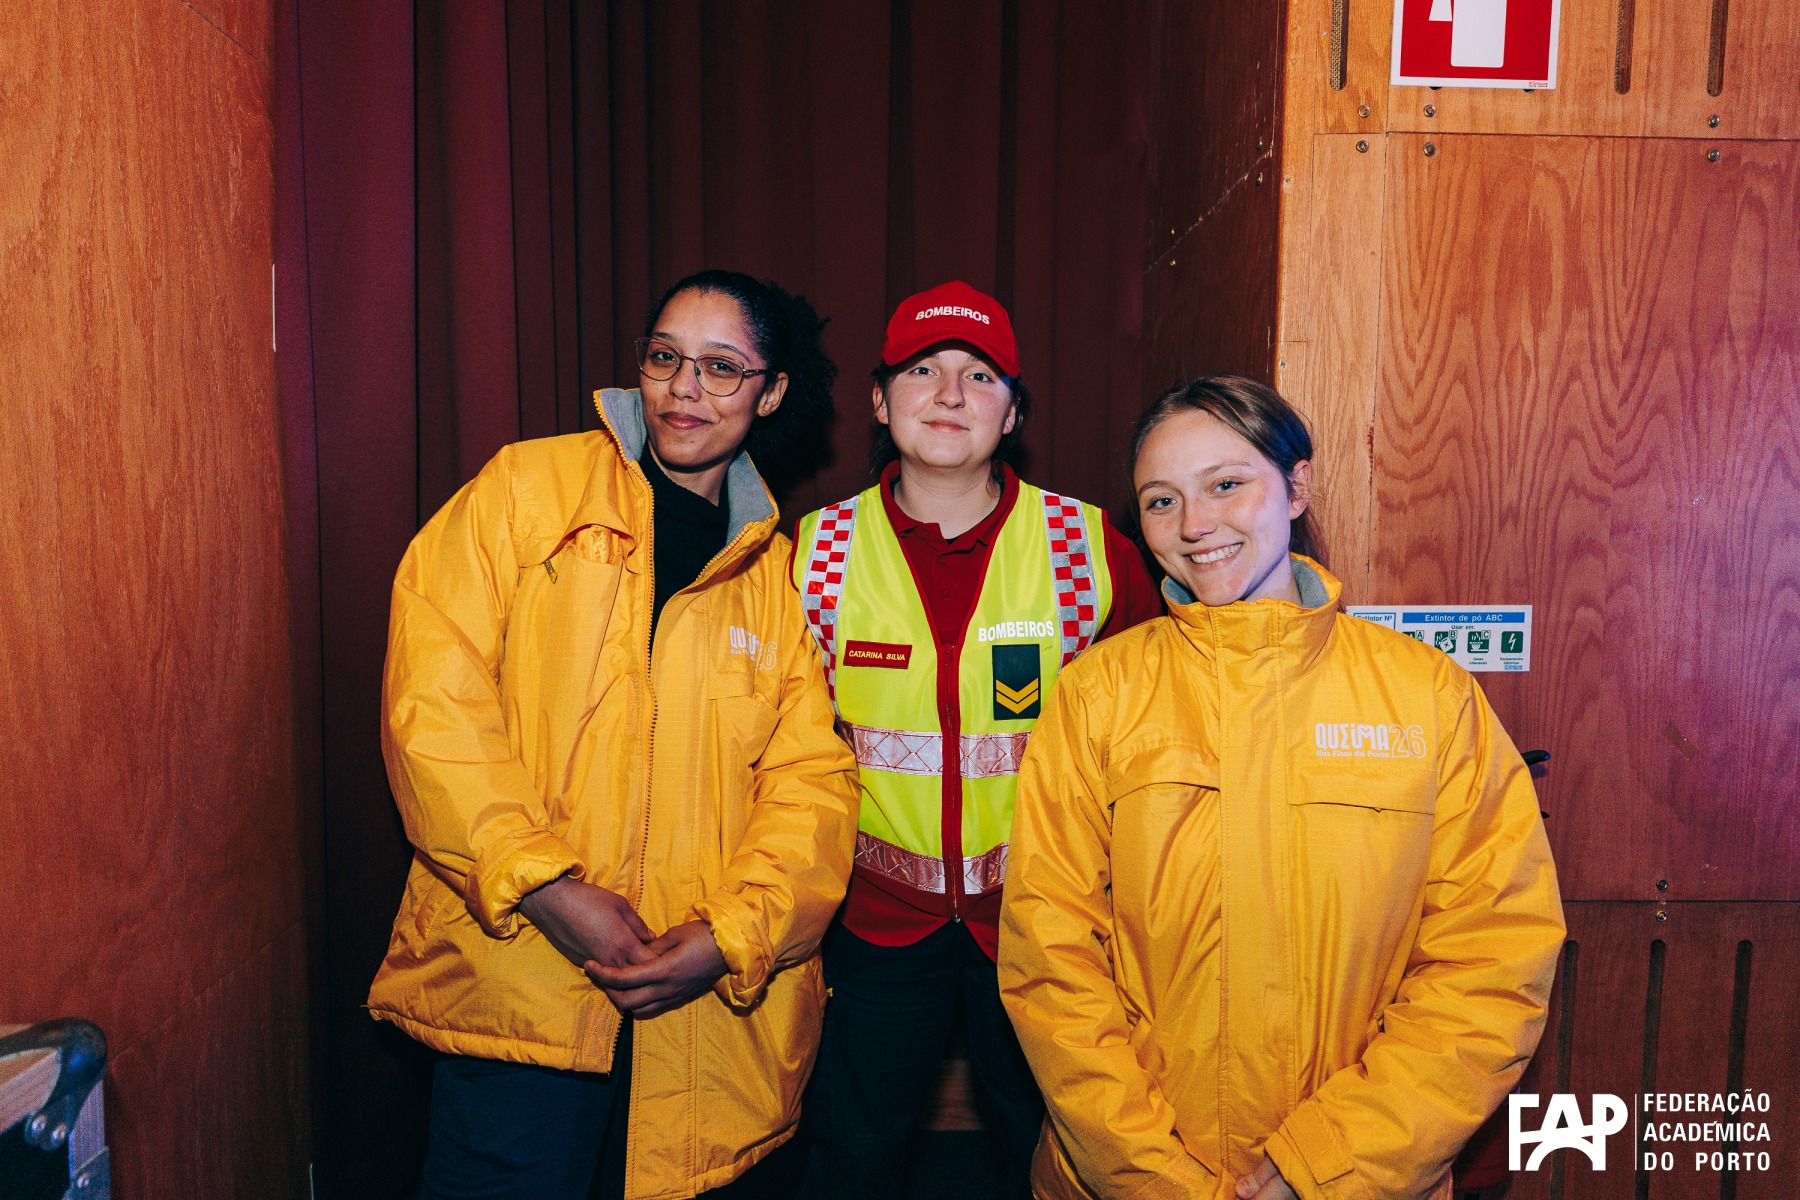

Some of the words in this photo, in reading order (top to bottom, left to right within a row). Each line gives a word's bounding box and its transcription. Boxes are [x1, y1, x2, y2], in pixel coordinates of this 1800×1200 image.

[915, 306, 990, 325] BOMBEIROS
[1425, 614, 1455, 622] Extintor
[1458, 614, 1468, 622] de
[1471, 614, 1482, 623] pó
[1485, 614, 1503, 622] ABC
[978, 620, 1055, 642] BOMBEIROS
[1416, 631, 1424, 639] A
[1450, 630, 1457, 638] B
[1482, 630, 1490, 638] C
[848, 650, 883, 660] CATARINA
[886, 653, 906, 661] SILVA
[1389, 723, 1427, 759] 26
